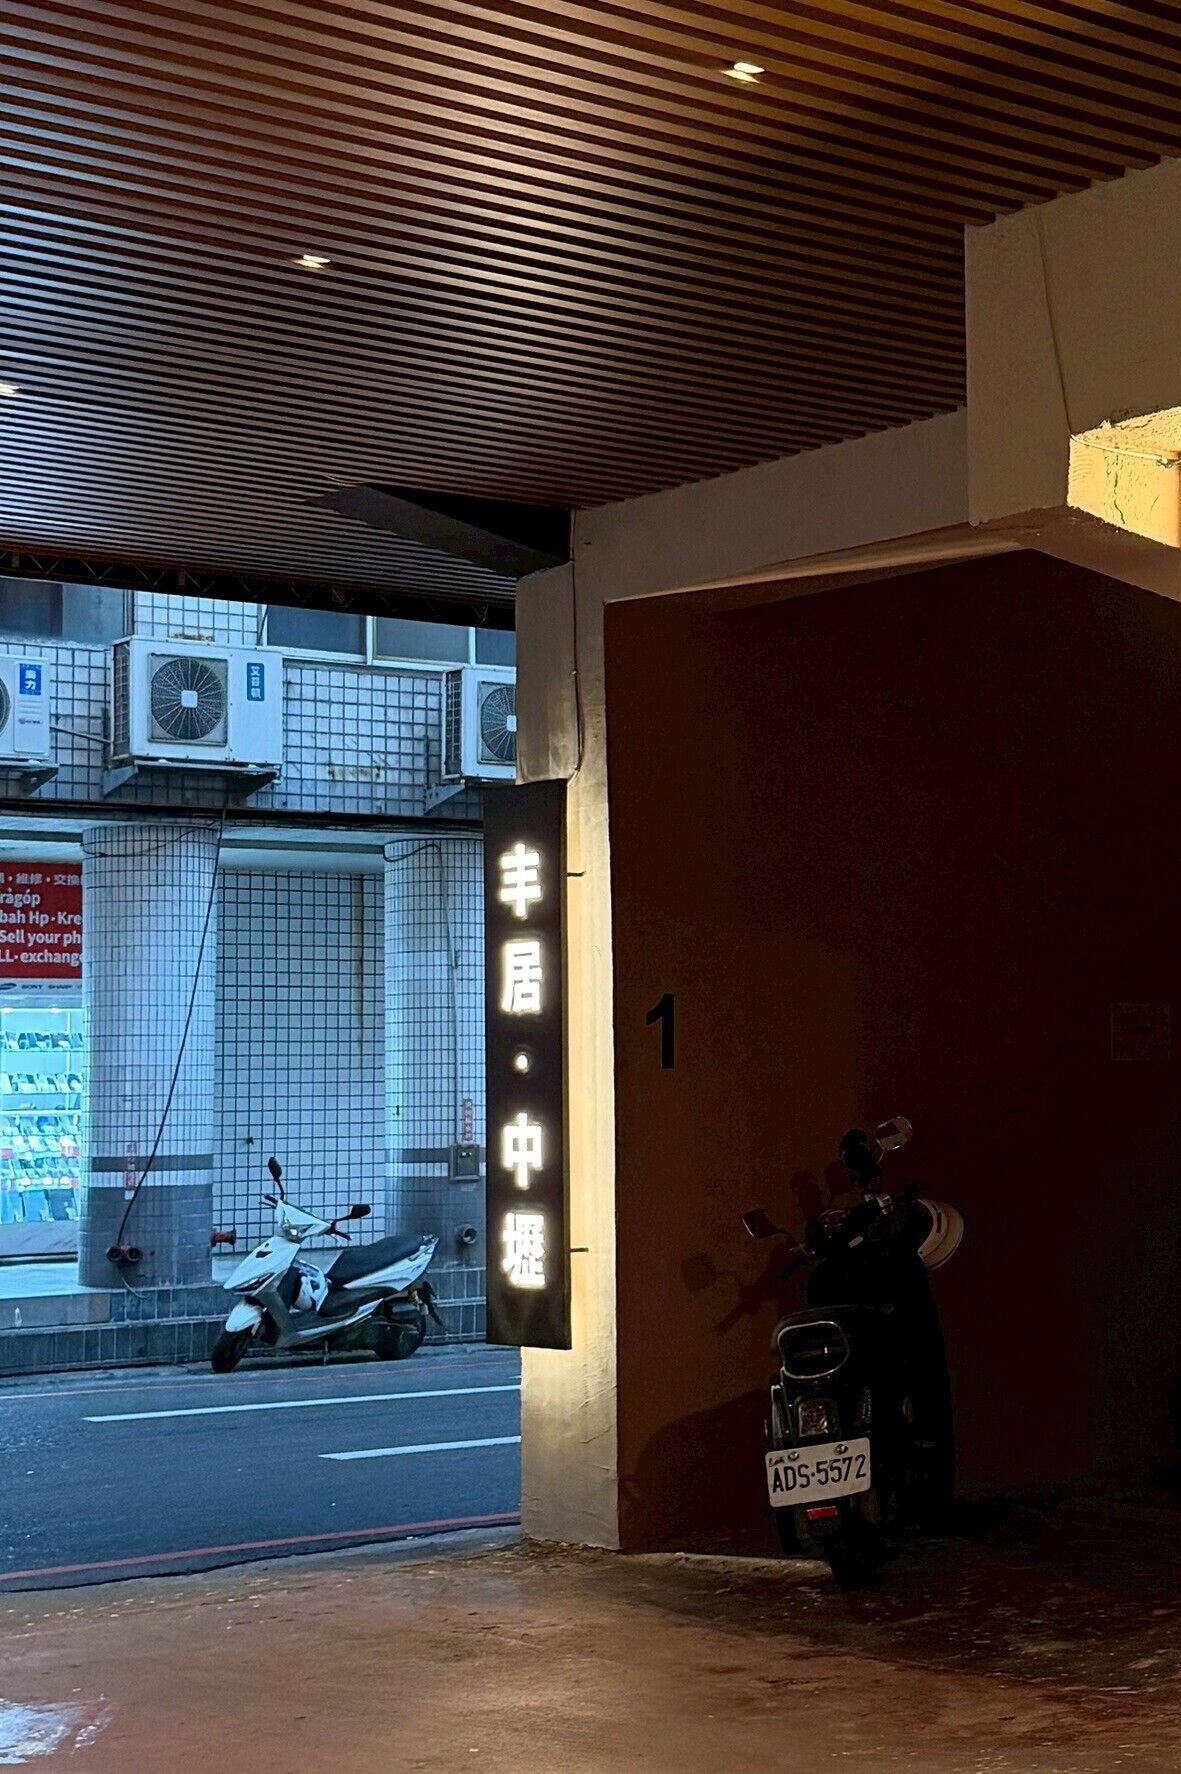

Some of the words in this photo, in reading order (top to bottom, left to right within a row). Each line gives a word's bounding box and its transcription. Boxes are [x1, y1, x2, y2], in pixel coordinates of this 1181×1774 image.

[0, 929, 25, 944] Sell
[27, 932, 61, 946] your
[645, 993, 675, 1069] 1
